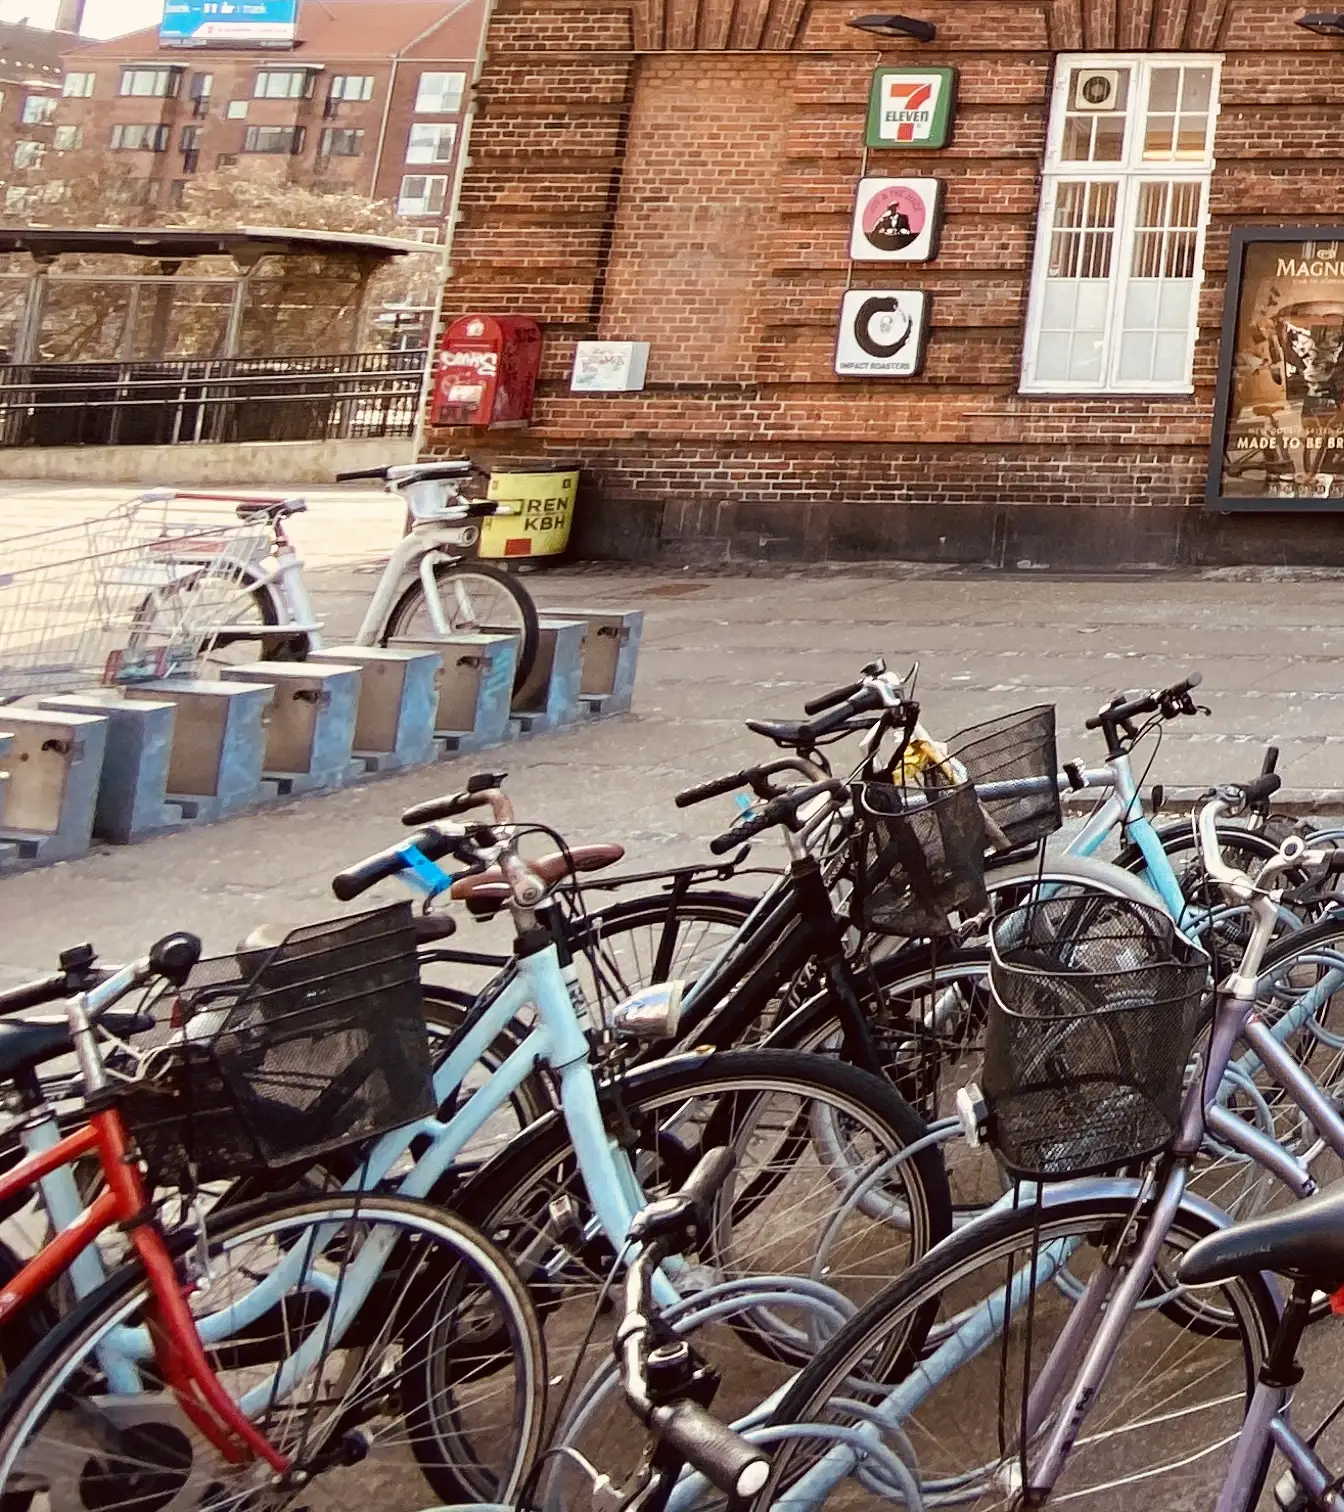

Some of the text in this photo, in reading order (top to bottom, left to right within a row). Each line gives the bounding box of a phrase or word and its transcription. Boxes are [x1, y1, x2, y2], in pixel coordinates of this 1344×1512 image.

[890, 83, 932, 141] 7
[1237, 437, 1277, 449] MADE
[1282, 437, 1301, 449] TO
[1306, 437, 1323, 449] BE
[527, 497, 569, 512] REN
[524, 515, 566, 531] KBH
